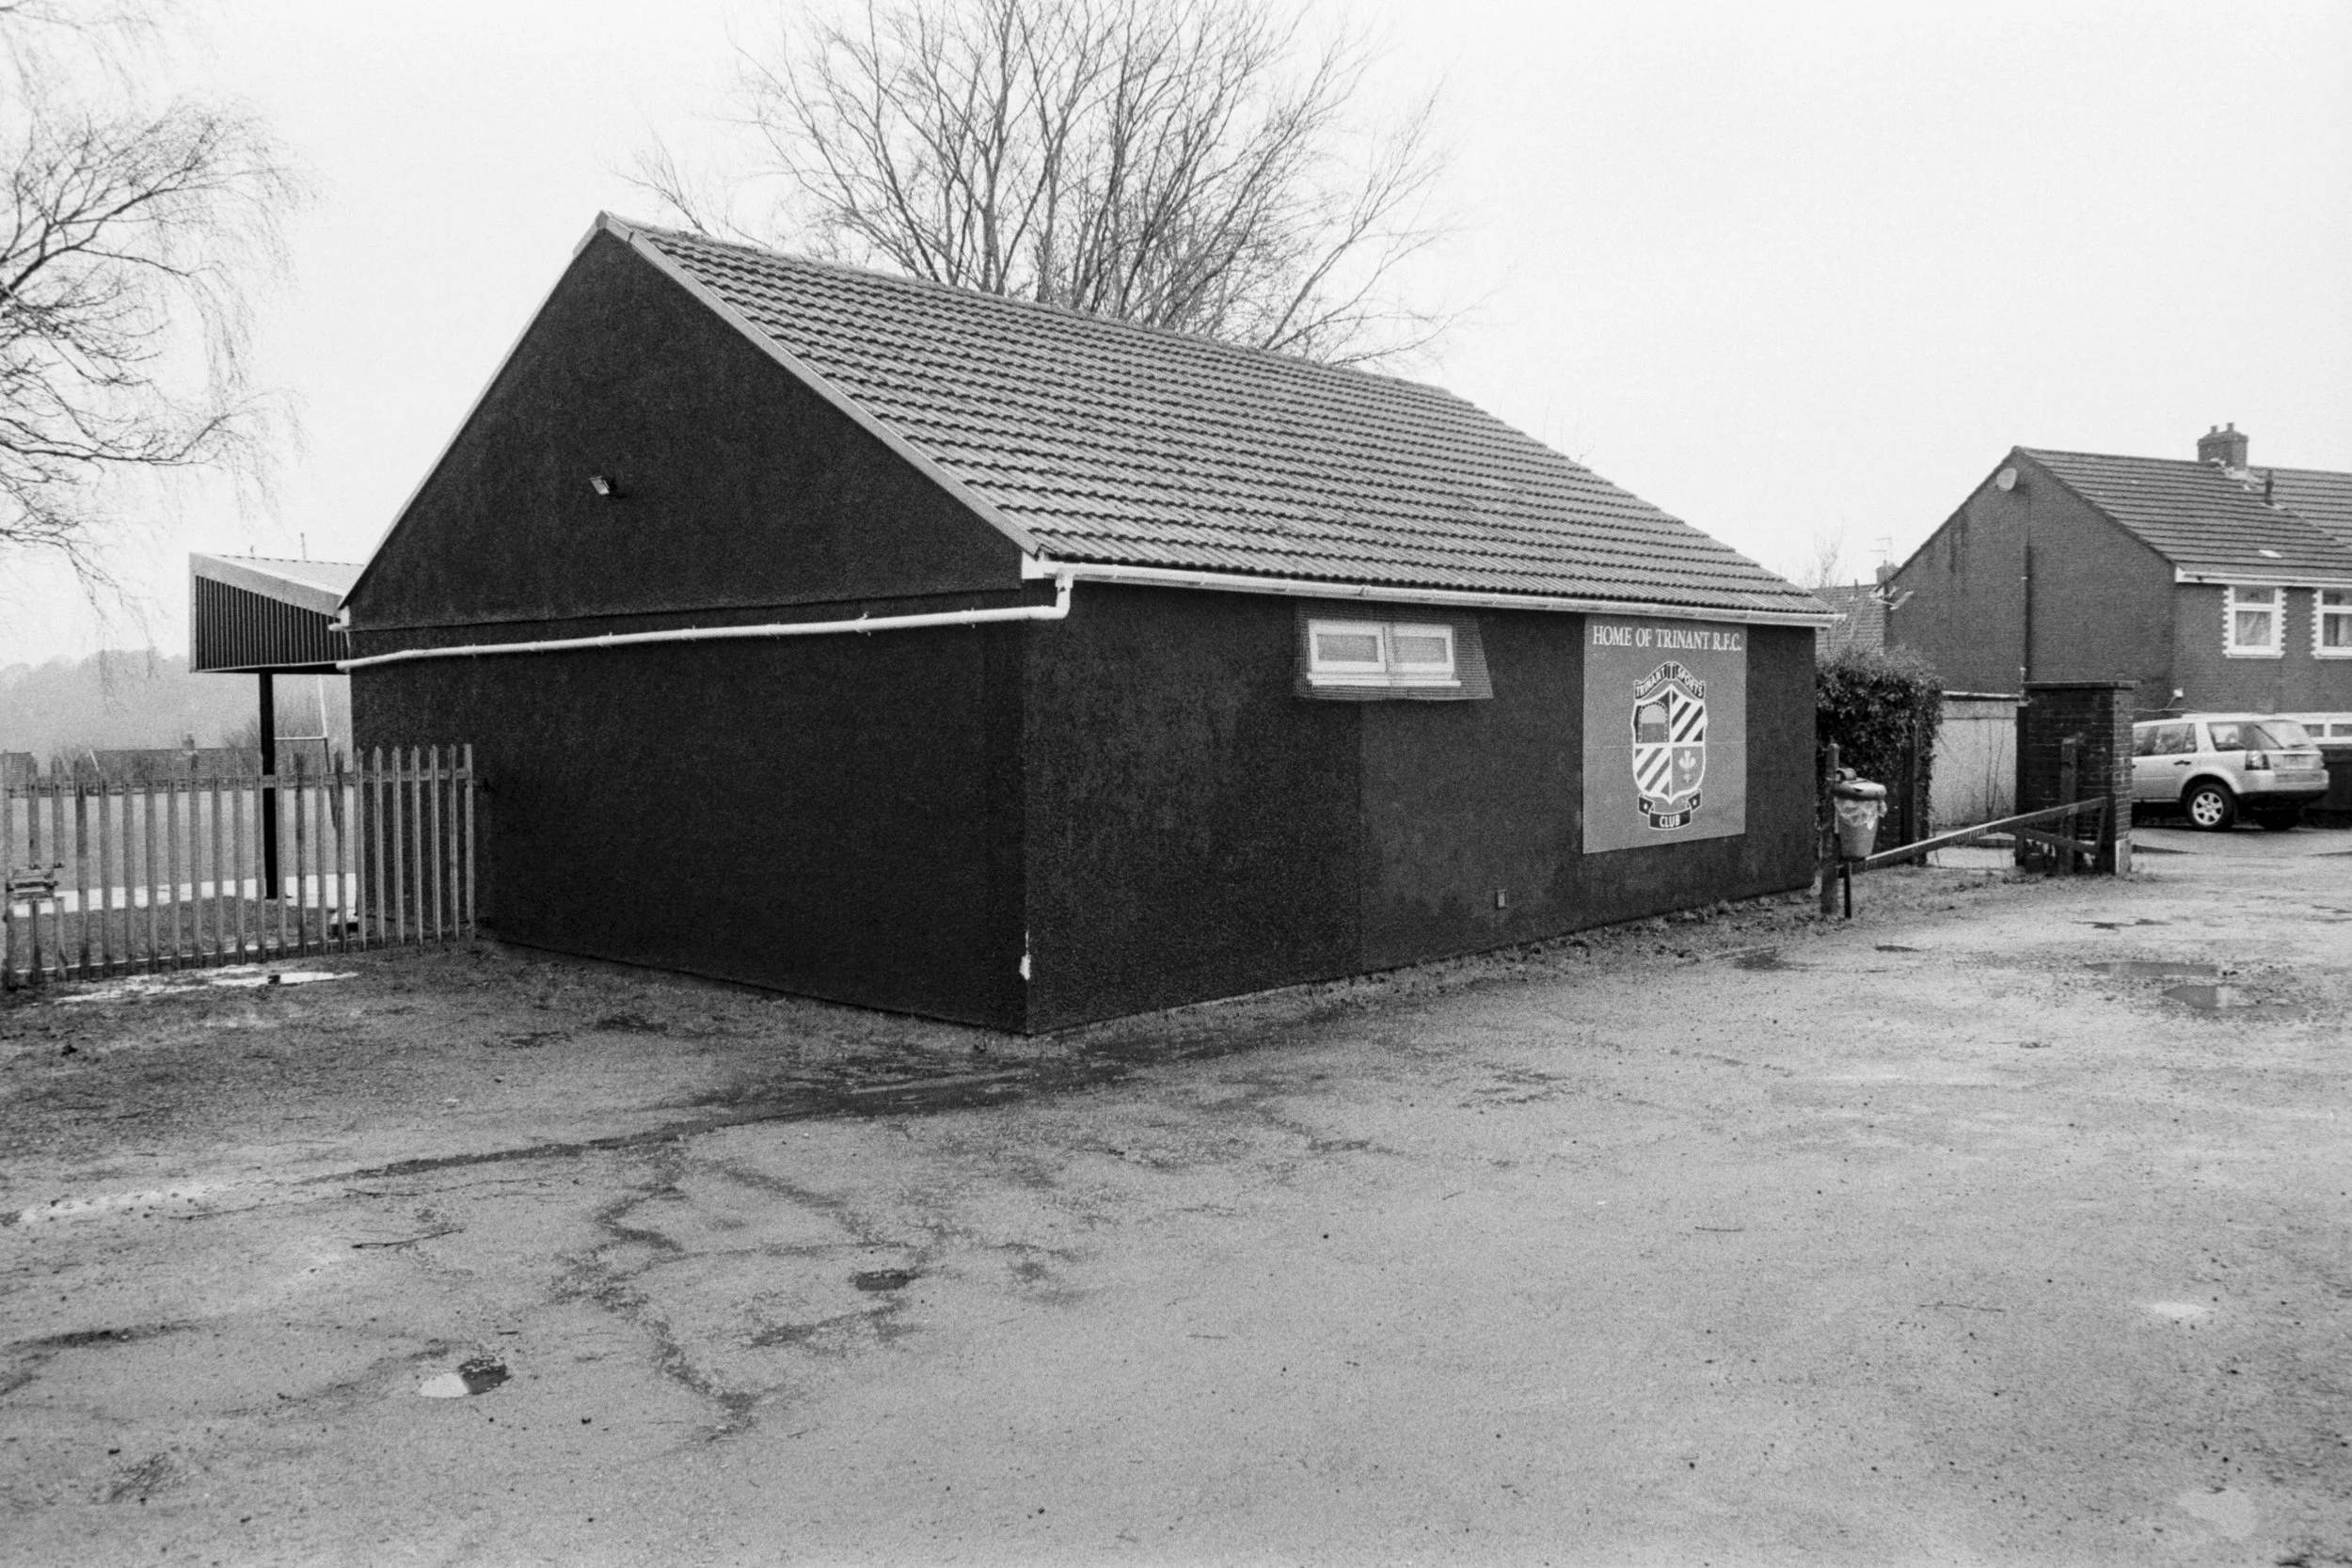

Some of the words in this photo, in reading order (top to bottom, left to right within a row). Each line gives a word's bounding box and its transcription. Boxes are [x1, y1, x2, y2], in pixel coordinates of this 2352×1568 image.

[1593, 626, 1632, 646] HOME
[1635, 627, 1652, 648] OF
[1656, 628, 1710, 650] TRINANT
[1712, 631, 1741, 651] R.F.C.
[1636, 667, 1666, 697] TRINANT
[1677, 667, 1704, 697] SPORTS
[1660, 815, 1680, 828] CLUB
